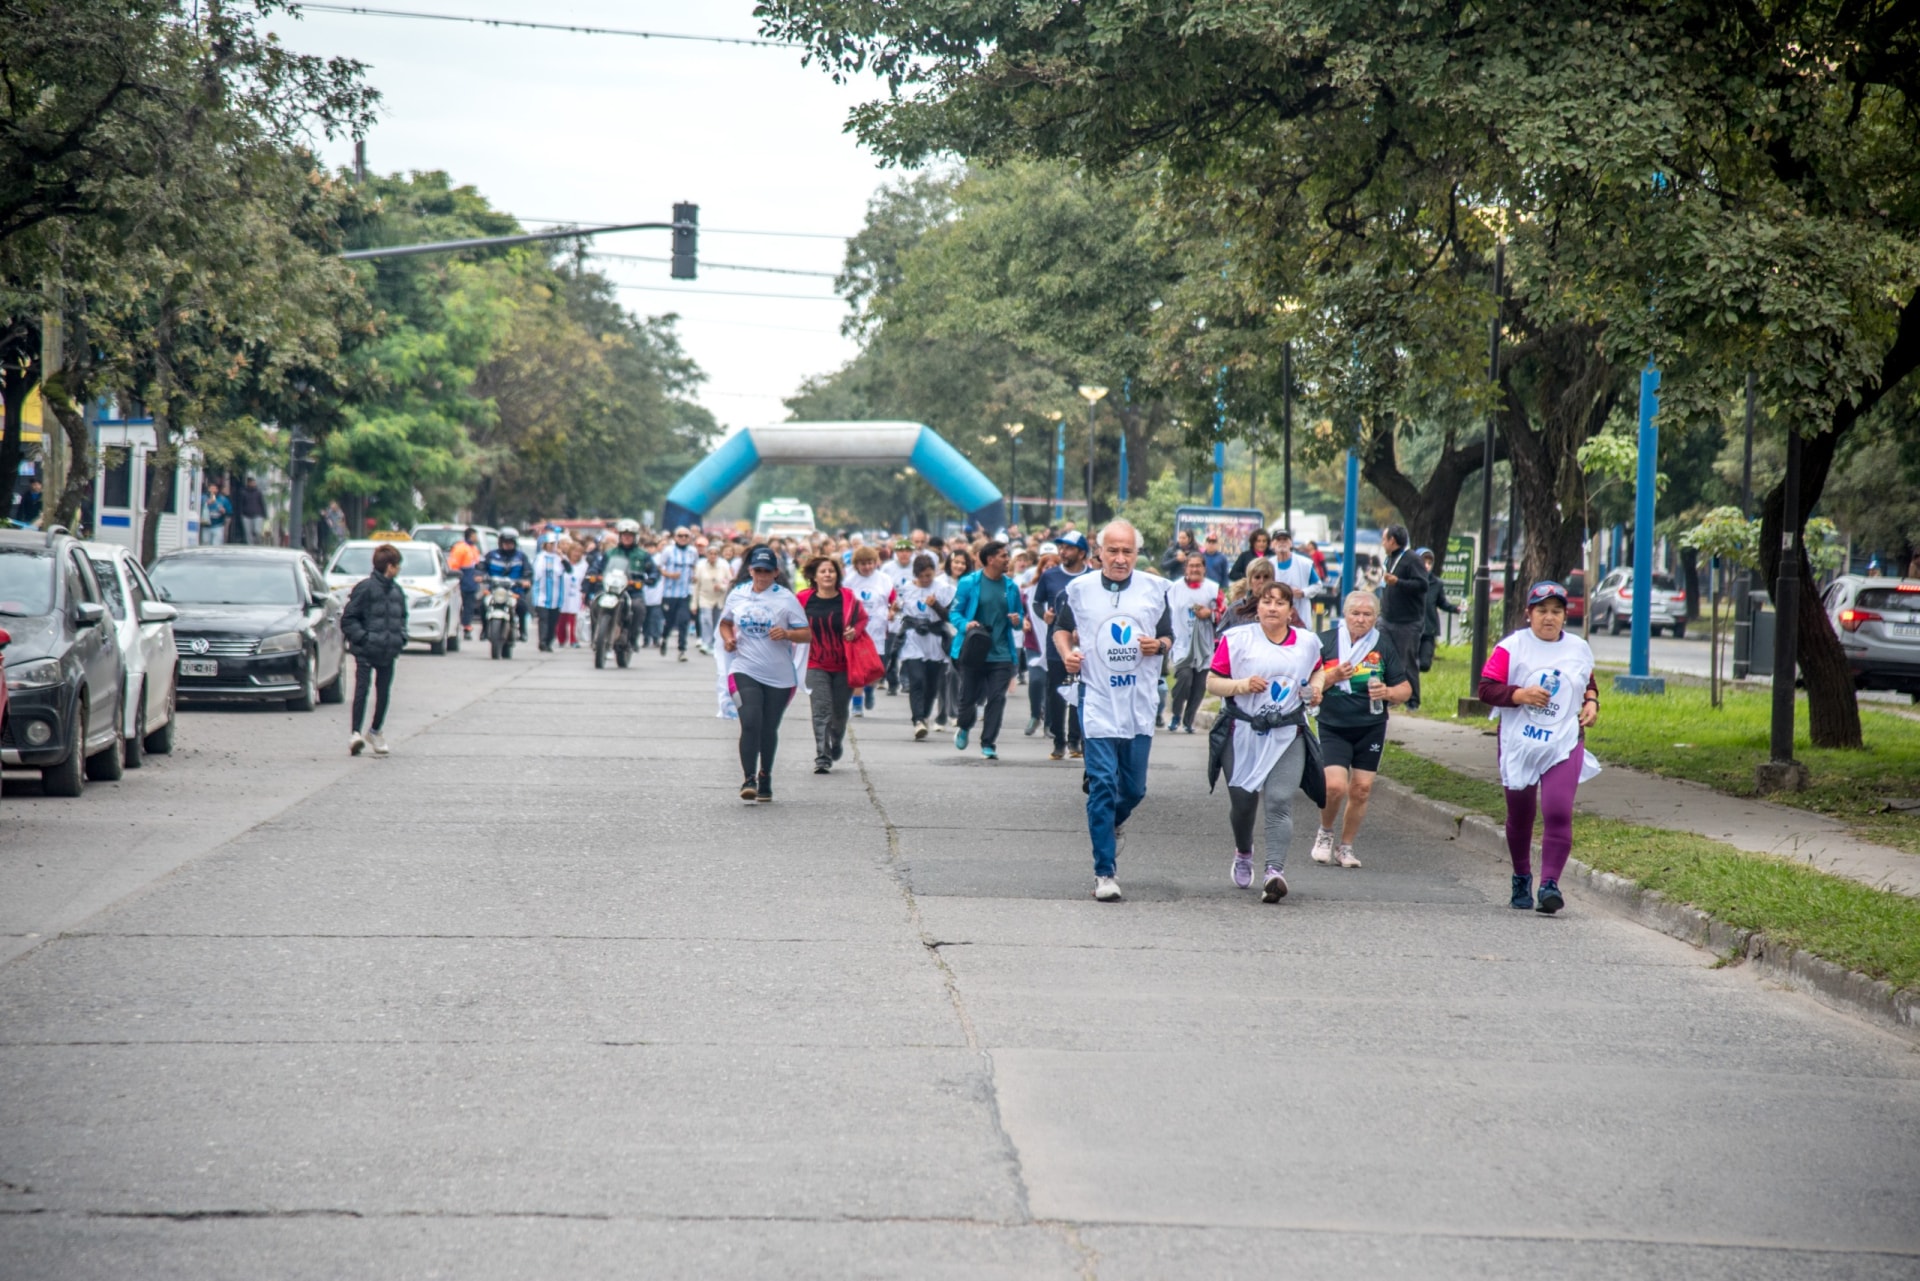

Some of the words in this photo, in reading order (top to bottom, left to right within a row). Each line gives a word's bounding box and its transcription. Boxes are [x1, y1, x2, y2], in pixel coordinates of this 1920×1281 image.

[1107, 647, 1138, 656] ADULTO
[1109, 654, 1137, 662] MAYOR
[1110, 674, 1137, 687] SMT
[1523, 724, 1553, 742] SMT
